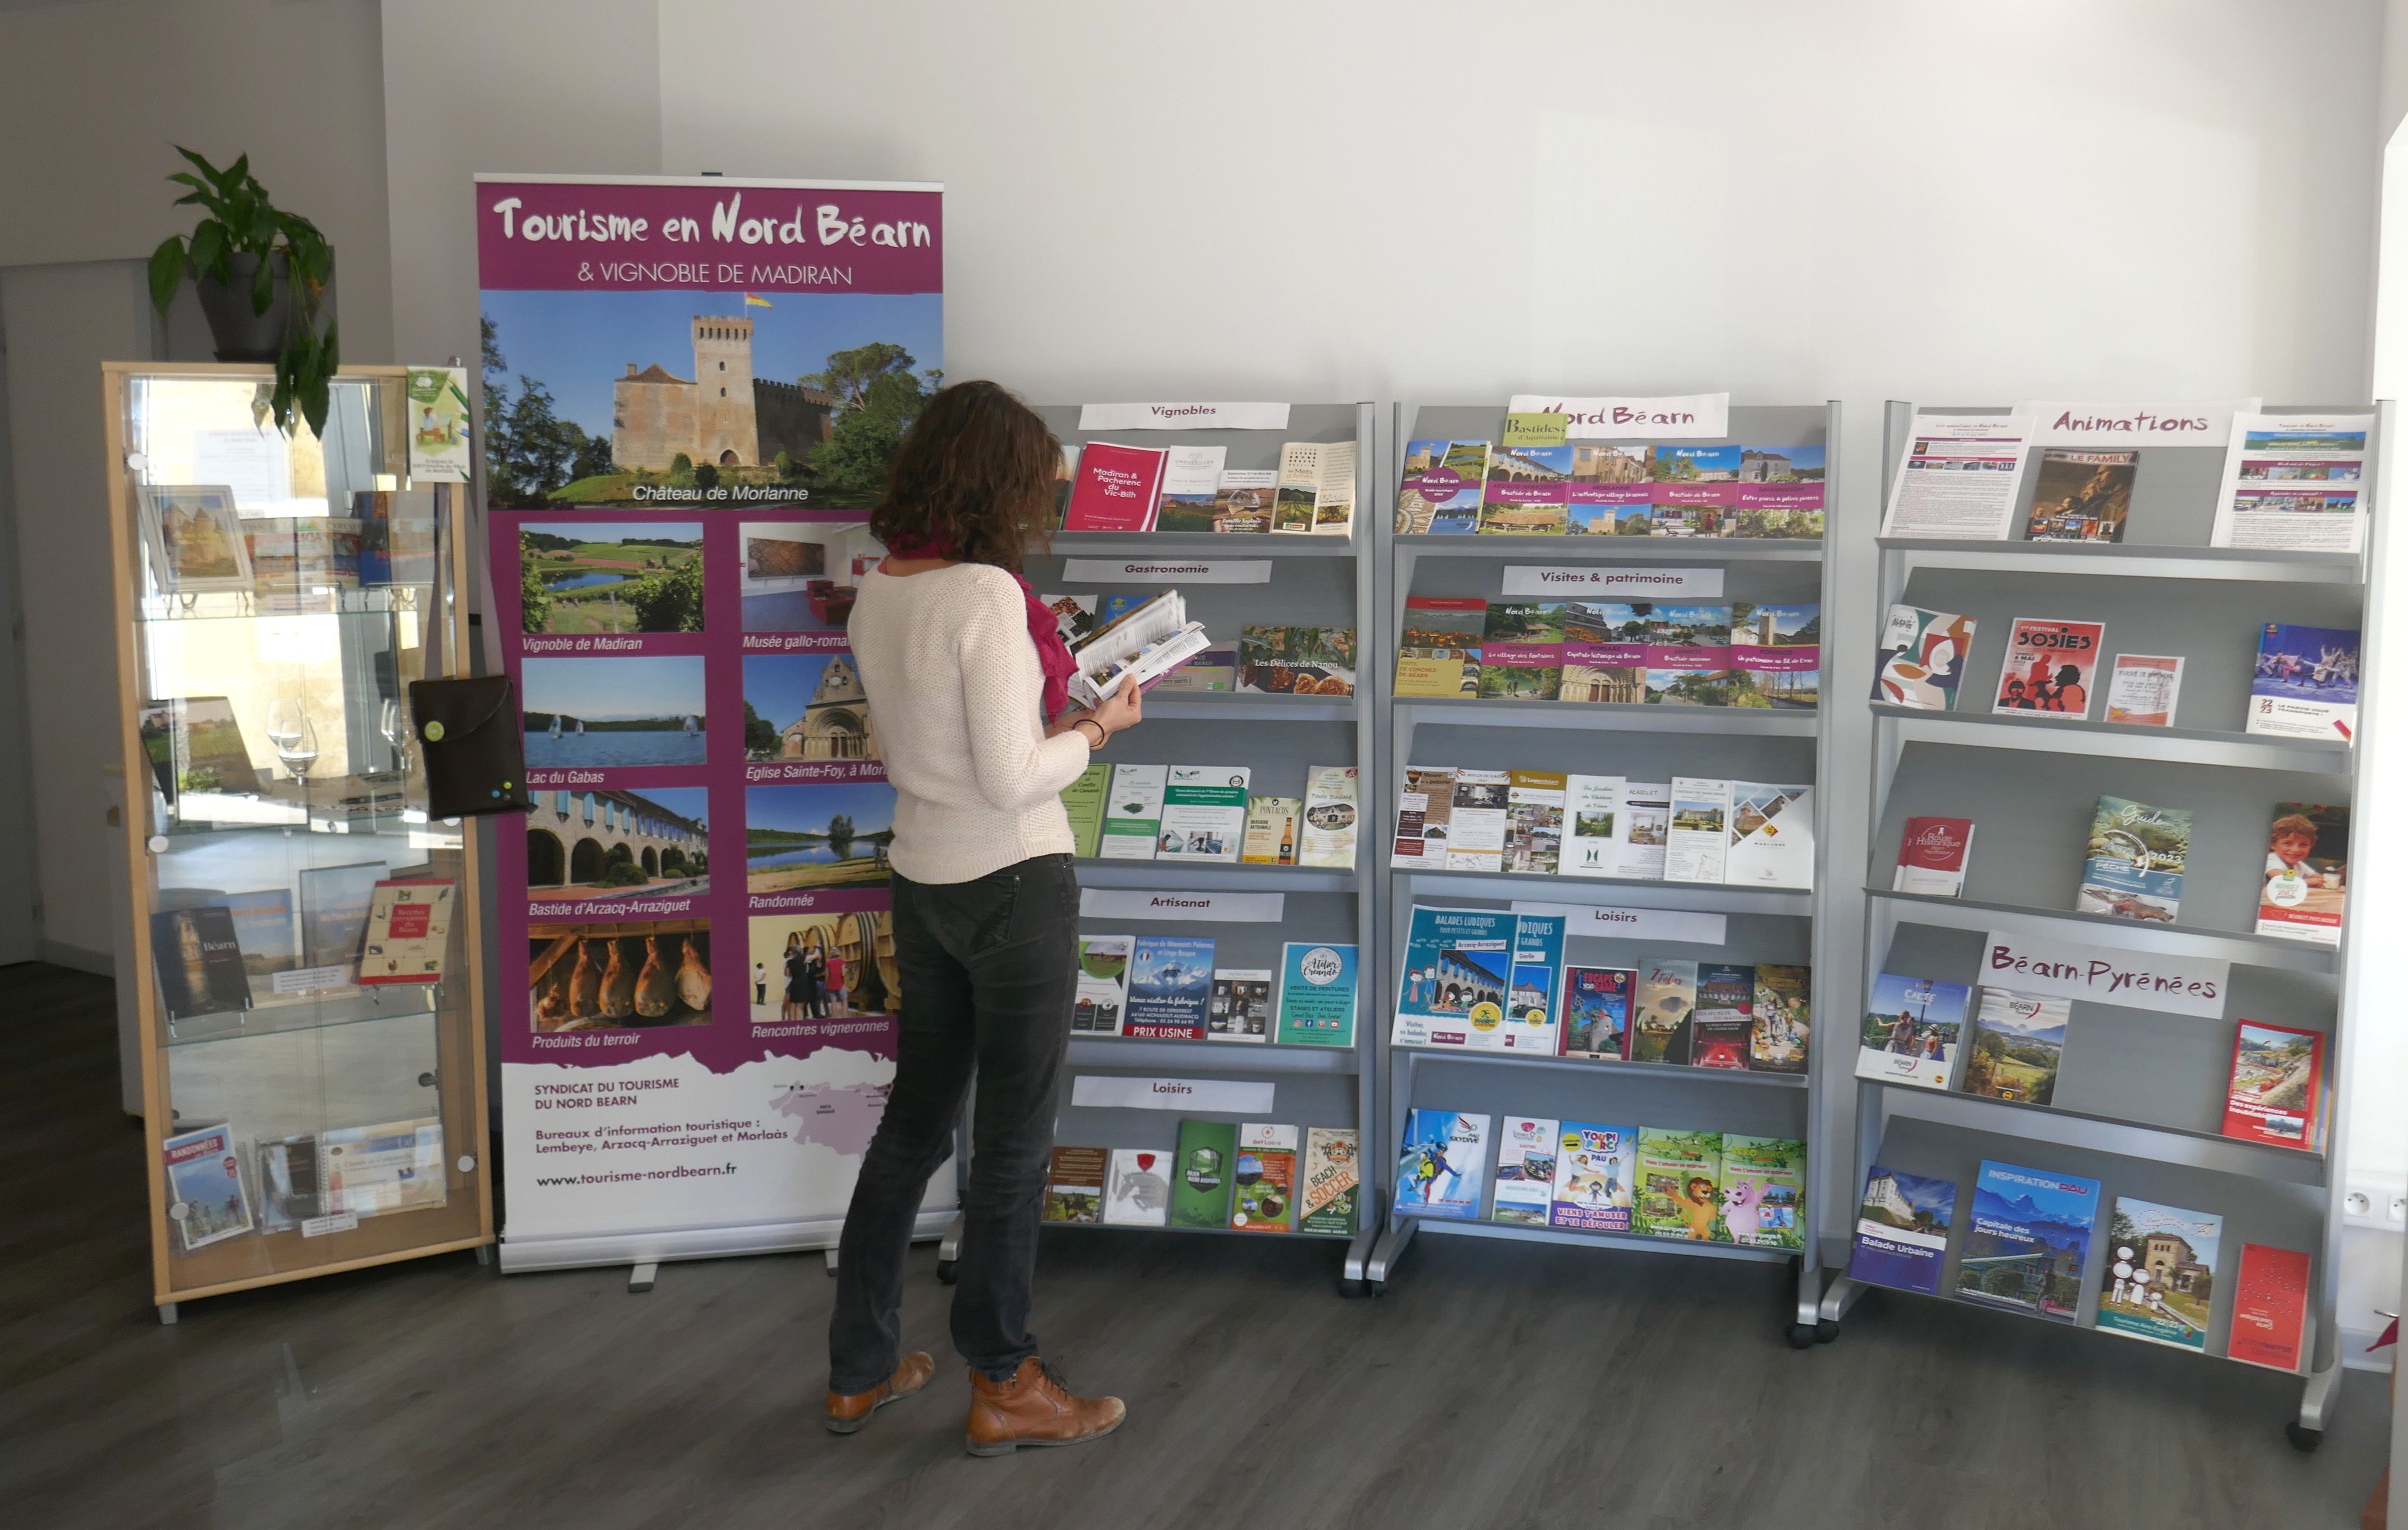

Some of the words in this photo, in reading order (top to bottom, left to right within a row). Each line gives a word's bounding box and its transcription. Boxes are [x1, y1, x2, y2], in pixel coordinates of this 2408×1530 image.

[494, 198, 649, 242] Tourisme
[663, 218, 700, 243] en
[712, 192, 805, 244] Nord
[817, 205, 930, 247] Béarn
[578, 263, 594, 281] &
[601, 263, 709, 283] VIGNOBLE
[719, 265, 744, 283] DE
[751, 266, 852, 285] MADIRAN
[1151, 406, 1216, 418] Vignobles
[1612, 407, 1694, 425] Béarn
[2053, 411, 2209, 434] Animations
[1676, 449, 1696, 458] Nord
[2088, 455, 2130, 463] FAMILY
[1093, 467, 1129, 479] Madiran
[1097, 475, 1141, 487] Pacherenc
[633, 486, 703, 501] Château
[707, 487, 728, 501] de
[732, 487, 809, 501] Morlanne
[1104, 489, 1136, 498] Vic-Bilh
[1125, 565, 1209, 574] Gastronomie
[1540, 572, 1587, 584] Visites
[1591, 573, 1602, 584] &
[1606, 573, 1683, 588] patrimoine
[522, 637, 572, 652] Vignoble
[575, 638, 591, 650] de
[594, 637, 642, 650] Madiran
[744, 635, 783, 648] Musée
[785, 635, 850, 650] gallo-roma
[527, 771, 547, 784] Lac
[549, 771, 565, 783] du
[568, 771, 604, 784] Gabas
[746, 767, 781, 781] Eglise
[784, 765, 846, 779] Sainte-Foy,
[849, 765, 857, 776] à
[2121, 805, 2165, 826] Guide
[1916, 837, 1961, 848] Historique
[1927, 833, 1953, 842] Route
[2150, 852, 2182, 864] 2023
[530, 903, 572, 916] Bastide
[575, 899, 691, 915] d'Arzacq-Arraziguet
[749, 894, 814, 908] Randonnée
[1151, 897, 1210, 908] Artisanat
[1435, 915, 1463, 925] BALADES
[1464, 916, 1496, 928] LUDIQUES
[1595, 910, 1637, 923] Loisirs
[204, 941, 236, 952] Béarn
[1521, 938, 1543, 946] GRANDS
[1309, 958, 1340, 969] Atelier
[1583, 972, 1613, 982] ESCAPE
[1992, 945, 2217, 1000] Béarn-Pyrénées
[1594, 982, 1618, 992] GAME
[2009, 1001, 2033, 1012] BÉARN
[752, 1025, 817, 1038] Rencontres
[820, 1021, 889, 1036] vigneronnes
[1133, 1027, 1157, 1037] PRIX
[1159, 1028, 1193, 1039] USINE
[532, 1035, 580, 1049] Produits
[585, 1035, 600, 1047] du
[603, 1032, 640, 1046] terroir
[535, 1084, 594, 1095] SYNDICAT
[598, 1082, 615, 1092] DU
[618, 1078, 680, 1091] TOURISME
[1153, 1083, 1192, 1094] Loisirs
[535, 1099, 552, 1110] DU
[556, 1097, 593, 1109] NORD
[597, 1095, 637, 1107] BEARN
[2244, 1103, 2288, 1115] expériences
[536, 1129, 589, 1140] Bureaux
[595, 1123, 681, 1137] d'information
[686, 1119, 752, 1133] touristique
[536, 1142, 597, 1155] Lembeye,
[601, 1134, 717, 1150] Arzacq-Arraziguet
[722, 1133, 733, 1143] et
[737, 1129, 788, 1142] Morlaàs
[1583, 1131, 1616, 1142] YOUPI
[1585, 1140, 1613, 1150] PARC
[537, 1163, 737, 1187] www.tourisme-nordbearn.fr
[1310, 1165, 1337, 1187] BEACH
[1309, 1171, 1354, 1206] SOCCER
[1306, 1199, 1314, 1208] &
[1557, 1208, 1583, 1216] VIENS
[1585, 1211, 1627, 1219] T'AMUSER
[1582, 1218, 1625, 1229] DÉFOULER
[1975, 1217, 2014, 1231] Capitale
[2016, 1226, 2030, 1234] des
[1974, 1226, 1997, 1238] jours
[1998, 1230, 2035, 1244] heureux
[1862, 1236, 1895, 1251] Balade
[1897, 1243, 1934, 1259] Urbaine
